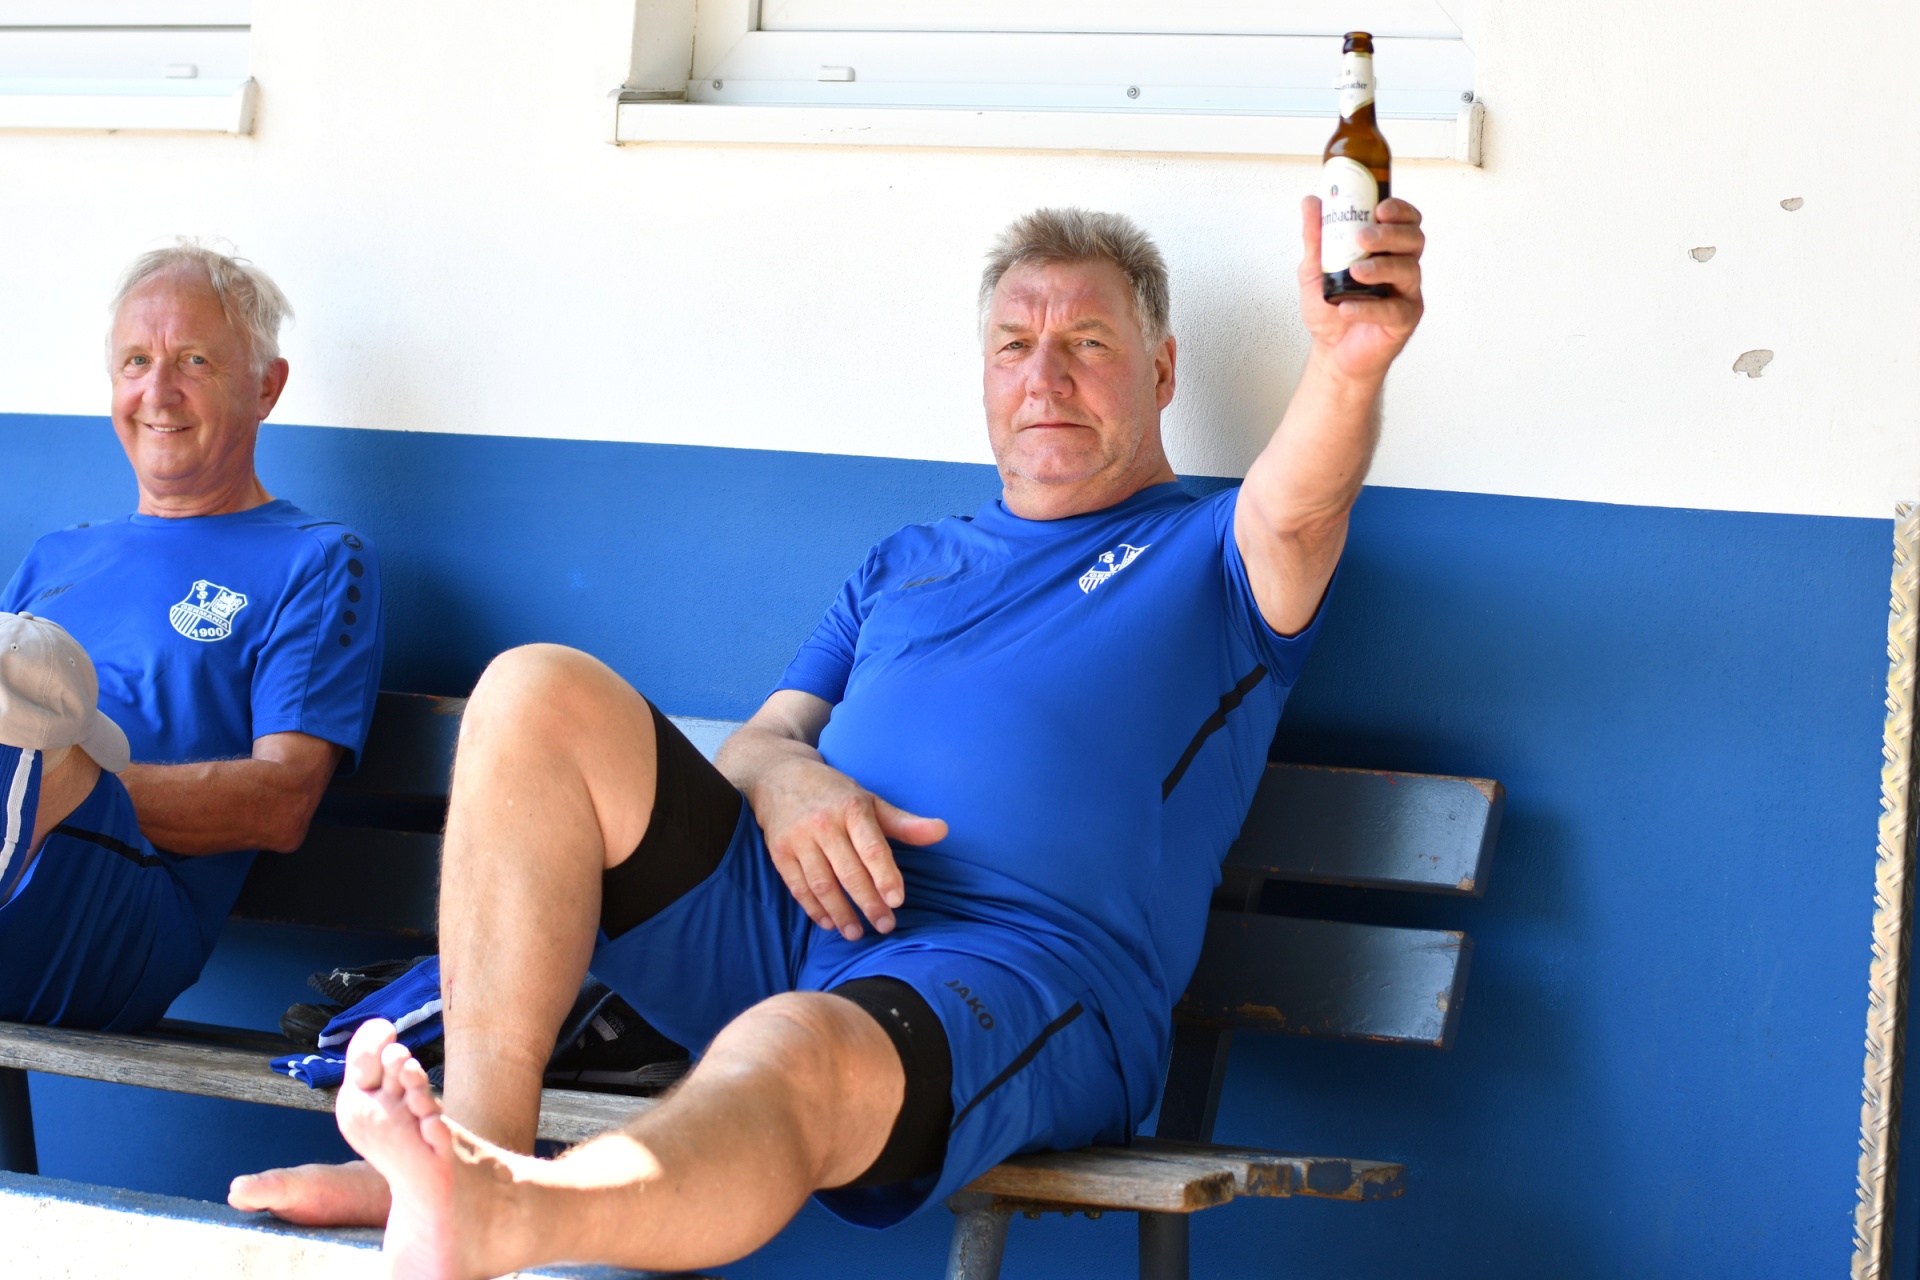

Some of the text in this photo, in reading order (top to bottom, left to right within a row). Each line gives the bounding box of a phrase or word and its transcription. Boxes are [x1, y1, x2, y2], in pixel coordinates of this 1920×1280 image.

[180, 603, 229, 629] GERMANIA
[191, 626, 225, 639] 1900
[943, 979, 995, 1031] JAKO
